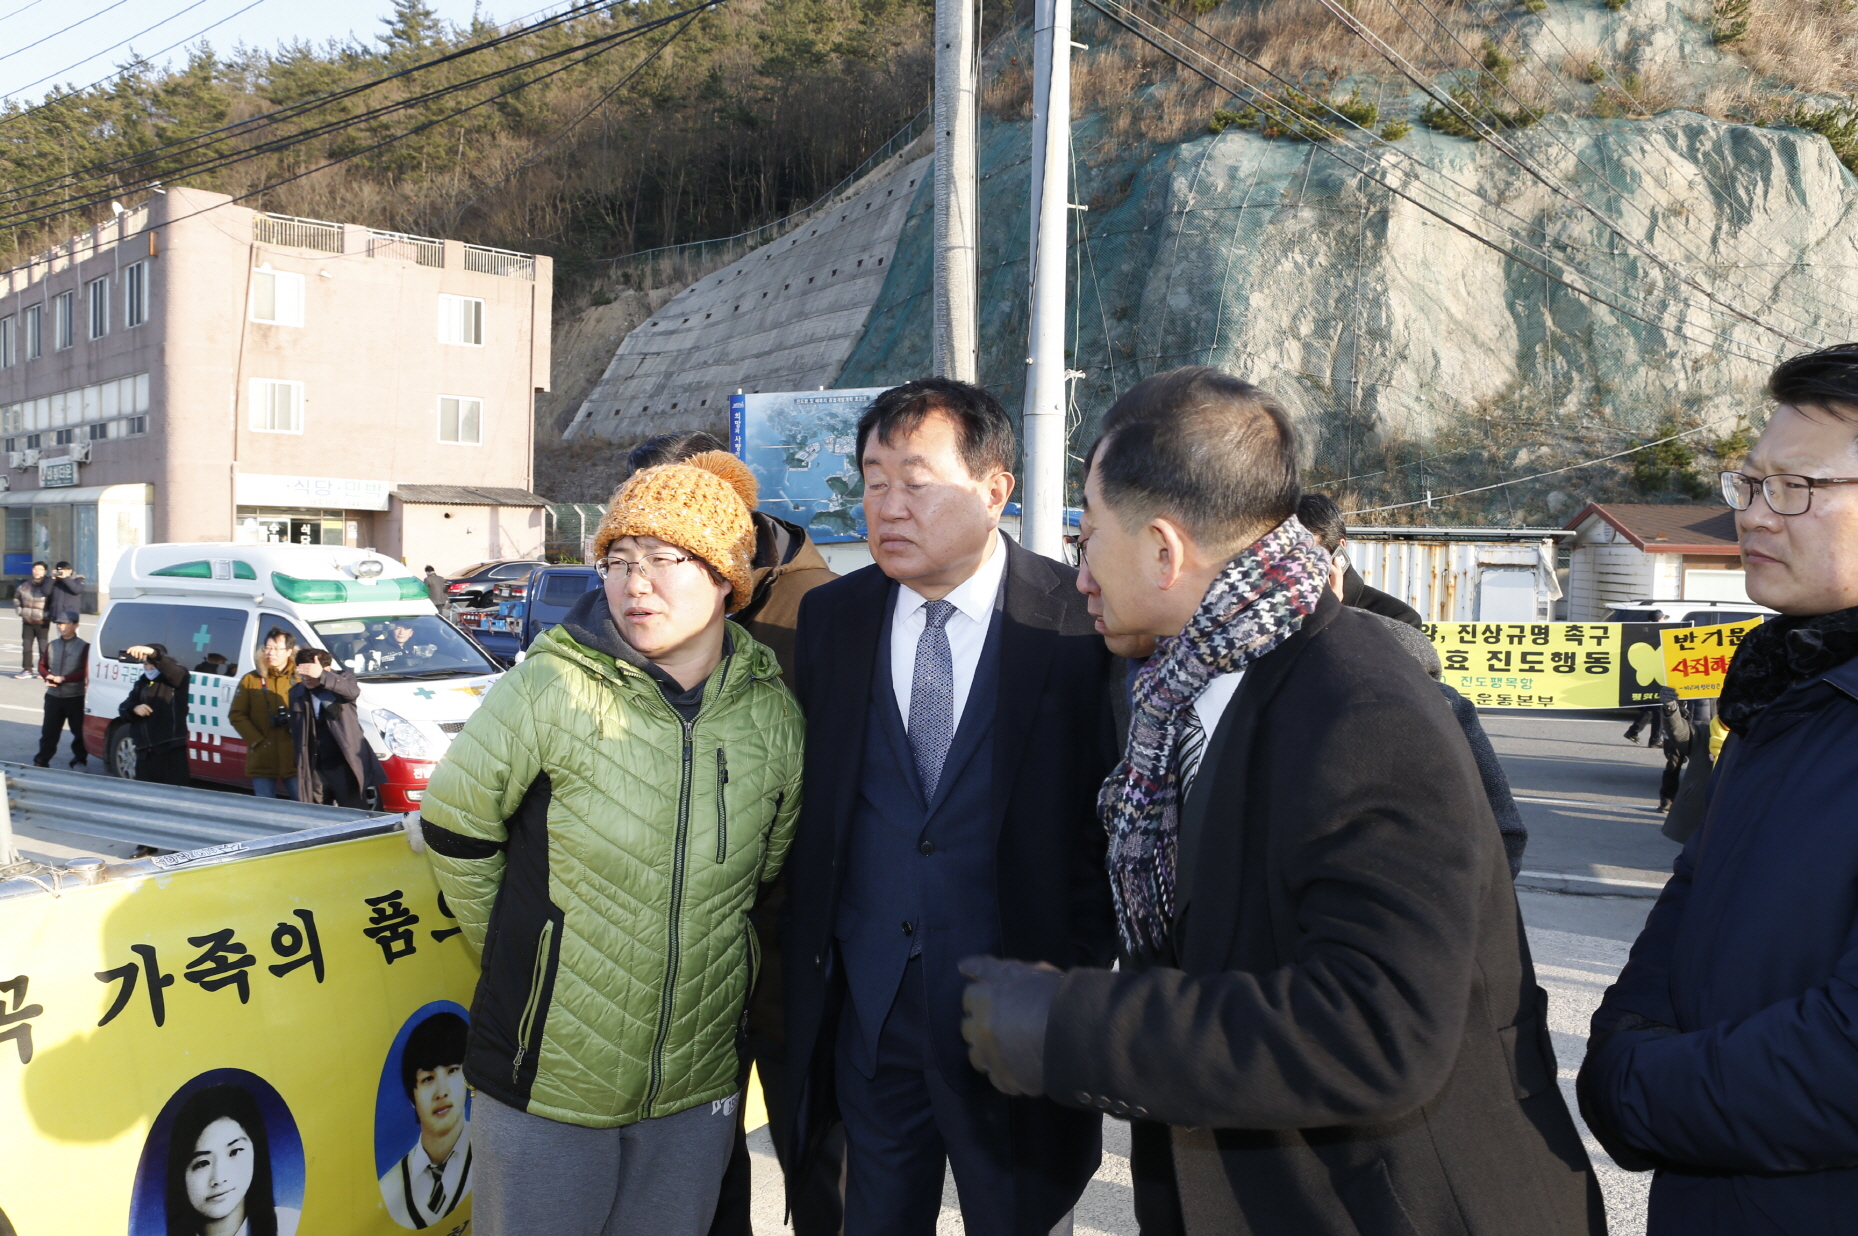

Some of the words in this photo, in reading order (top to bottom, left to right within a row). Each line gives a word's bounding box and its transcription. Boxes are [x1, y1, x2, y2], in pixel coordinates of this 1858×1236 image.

[293, 480, 333, 496] 식당
[344, 481, 383, 498] 민박
[1457, 624, 1550, 646] 진상규명
[1564, 625, 1610, 646] 촉구
[1674, 628, 1745, 651] 반기문
[96, 662, 119, 680] 119
[1486, 650, 1611, 674] 진도행동
[1671, 655, 1733, 677] 사죄하
[1460, 675, 1534, 690] 진도팽목항
[94, 908, 324, 1027] 가족의
